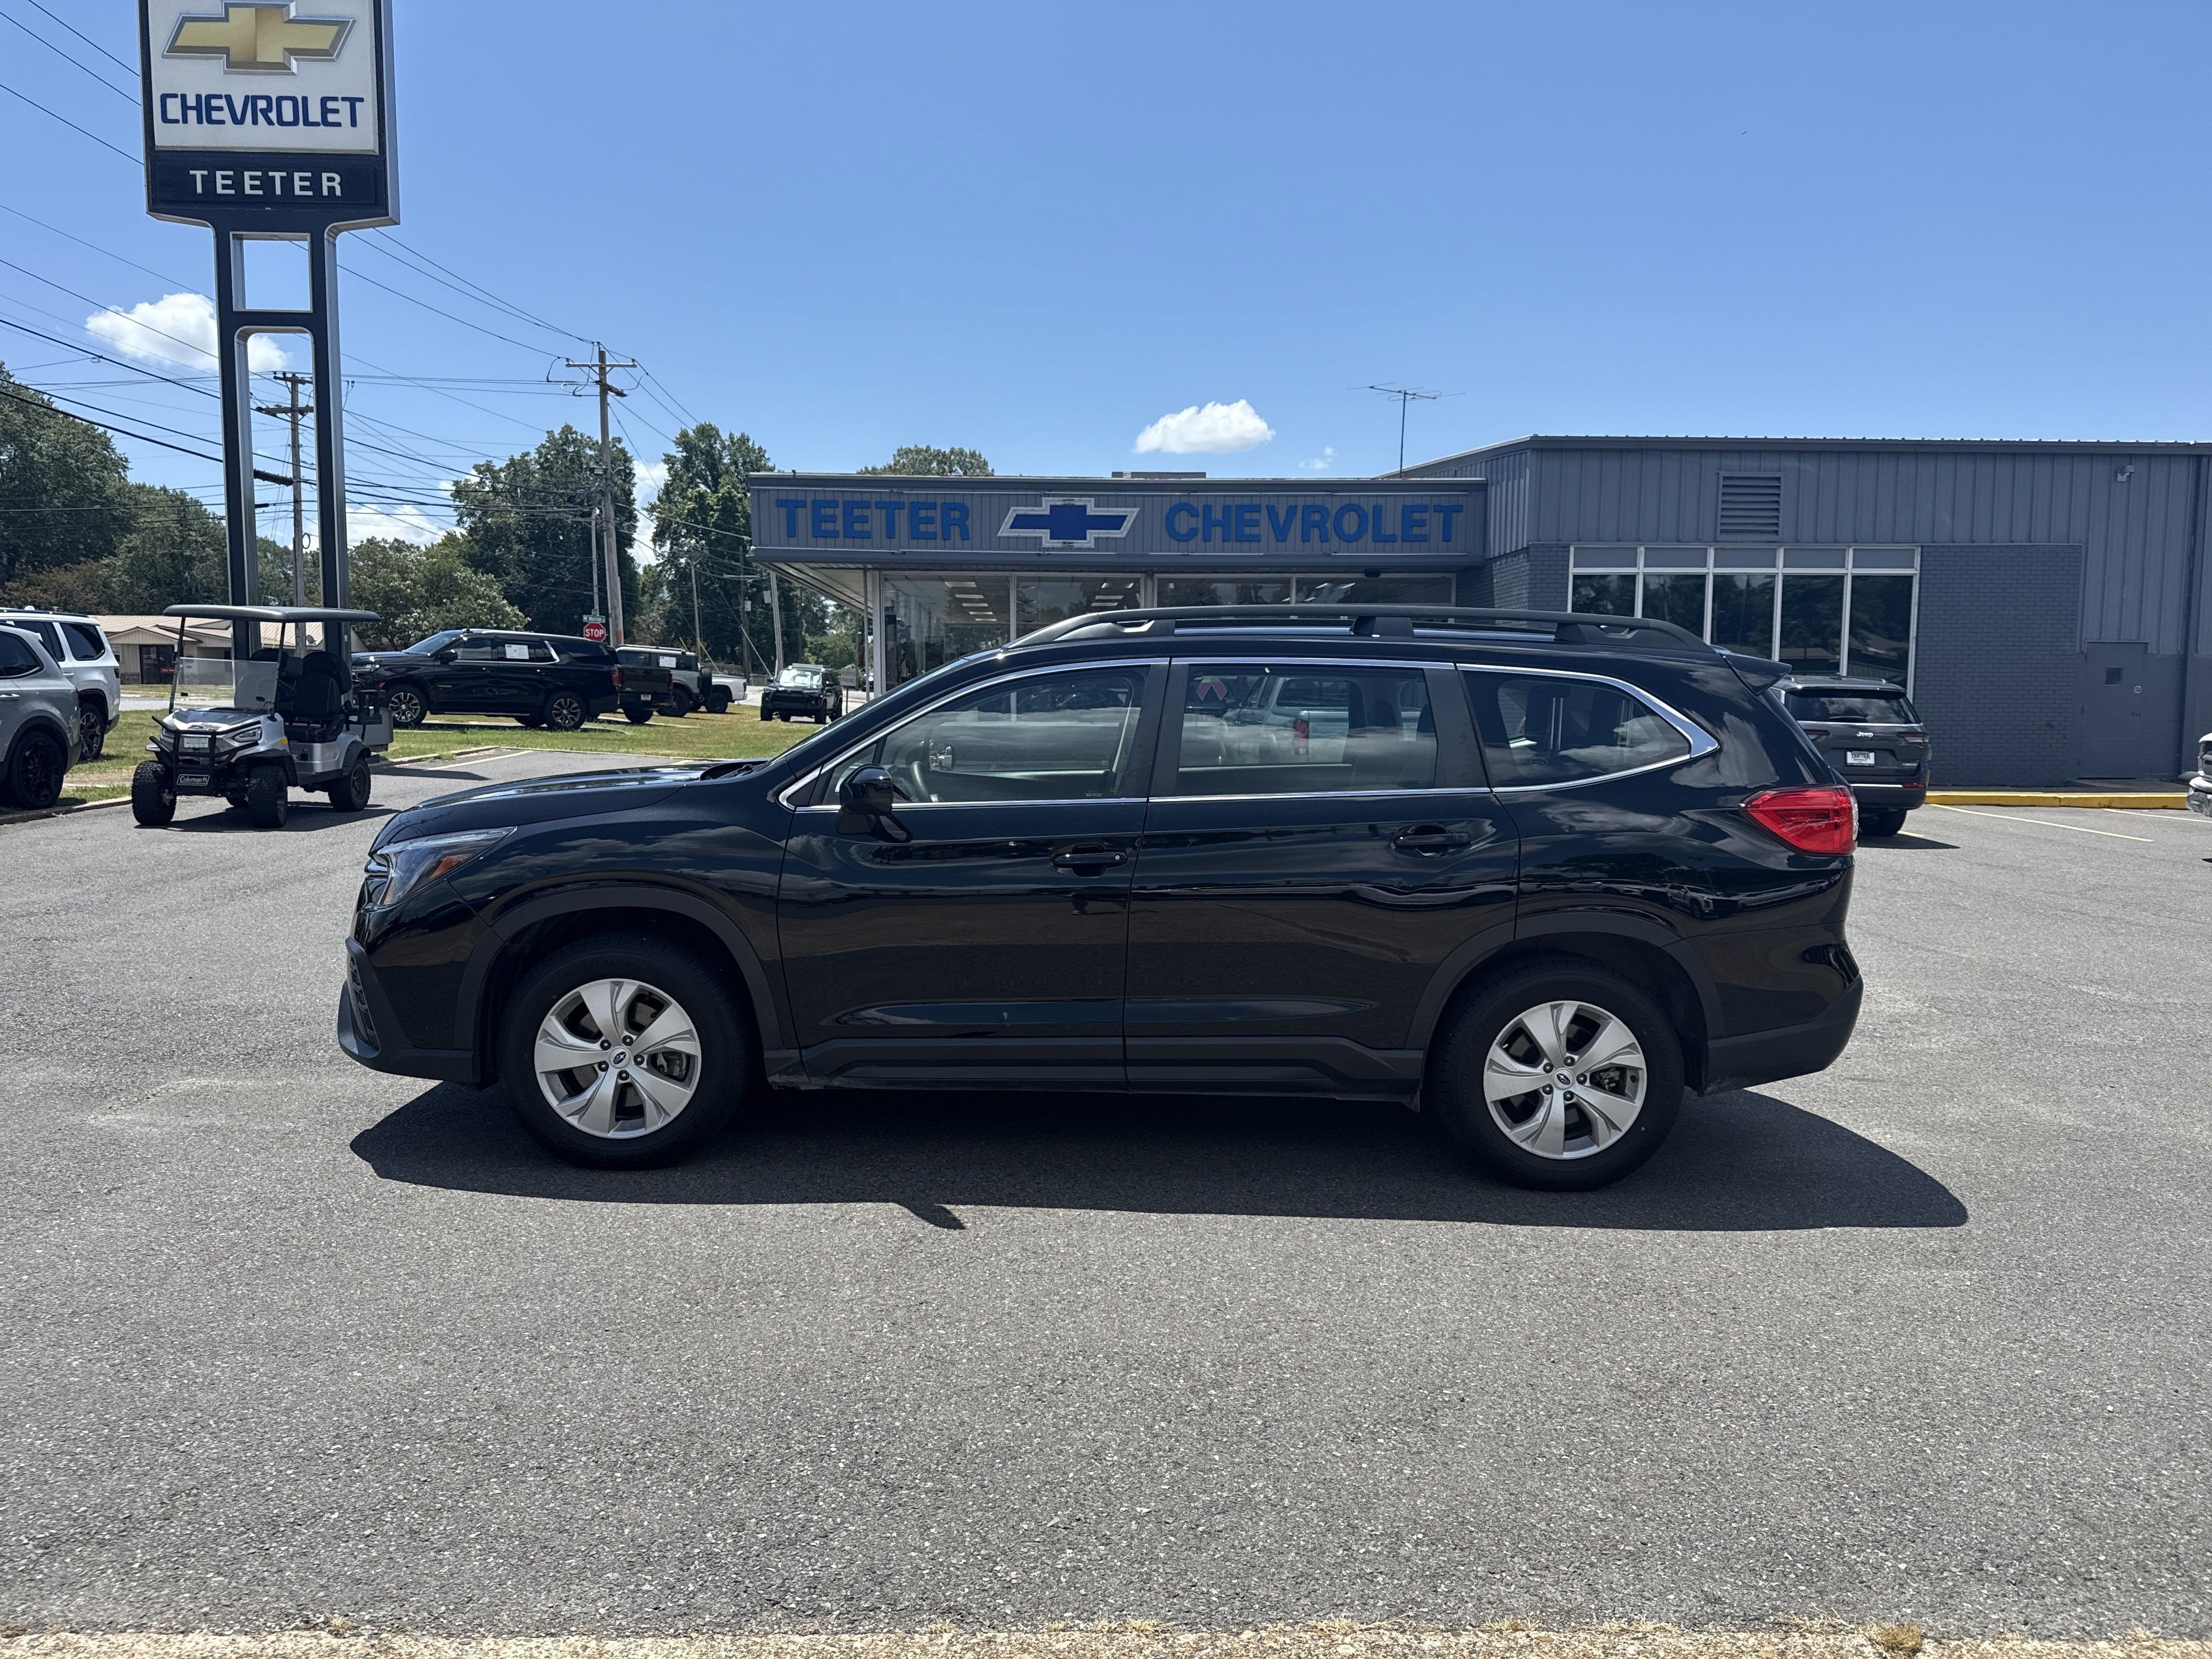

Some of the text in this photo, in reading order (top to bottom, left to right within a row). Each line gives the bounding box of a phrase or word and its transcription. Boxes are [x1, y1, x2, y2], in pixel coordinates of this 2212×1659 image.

[160, 93, 365, 128] CHEVROLET
[189, 170, 342, 197] TEETER
[776, 499, 1464, 543] TEETER CHEVROLET
[585, 628, 605, 637] STOP
